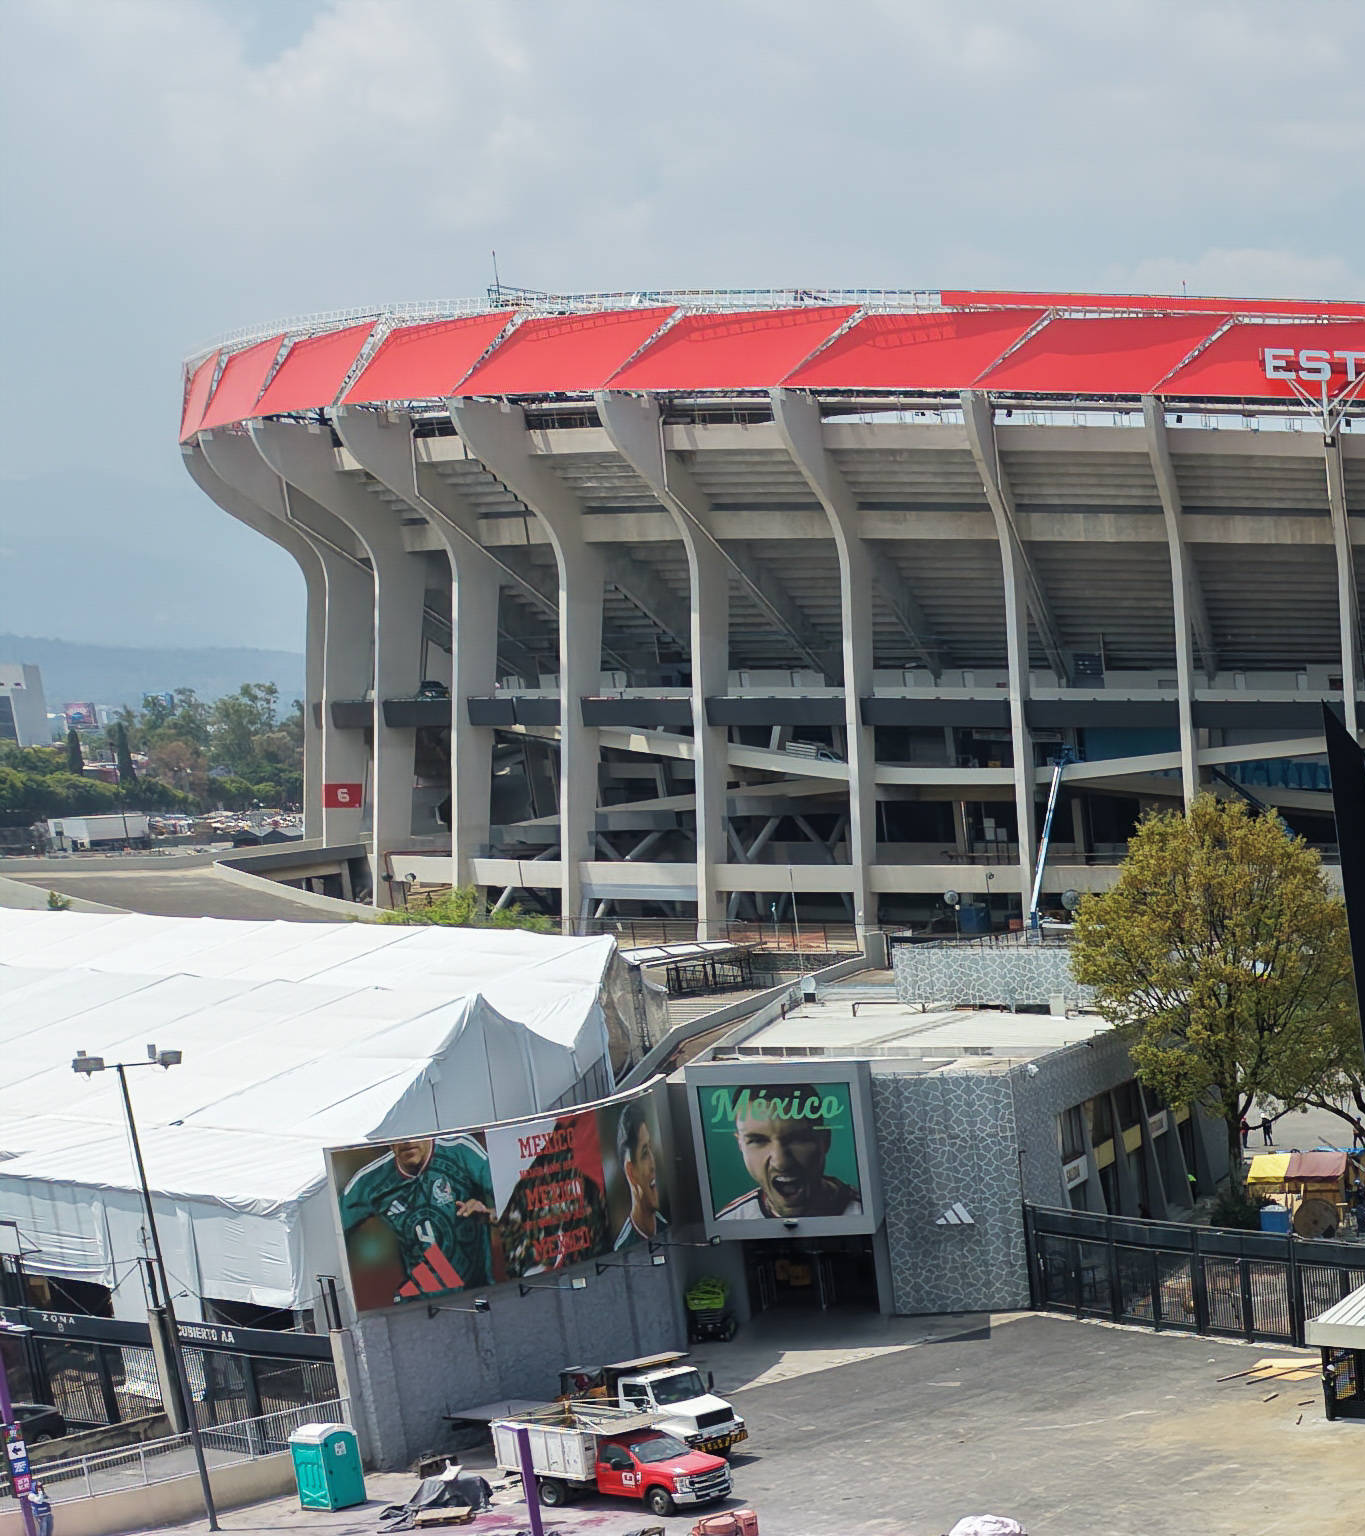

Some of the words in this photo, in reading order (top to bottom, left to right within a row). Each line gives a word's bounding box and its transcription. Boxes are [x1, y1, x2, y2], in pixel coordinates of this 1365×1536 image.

[337, 788, 350, 802] 6
[711, 1087, 845, 1124] México
[517, 1127, 576, 1159] MEXICO
[525, 1177, 584, 1211] MEXICO
[532, 1226, 591, 1262] MEXICO
[41, 1313, 76, 1325] ZONA
